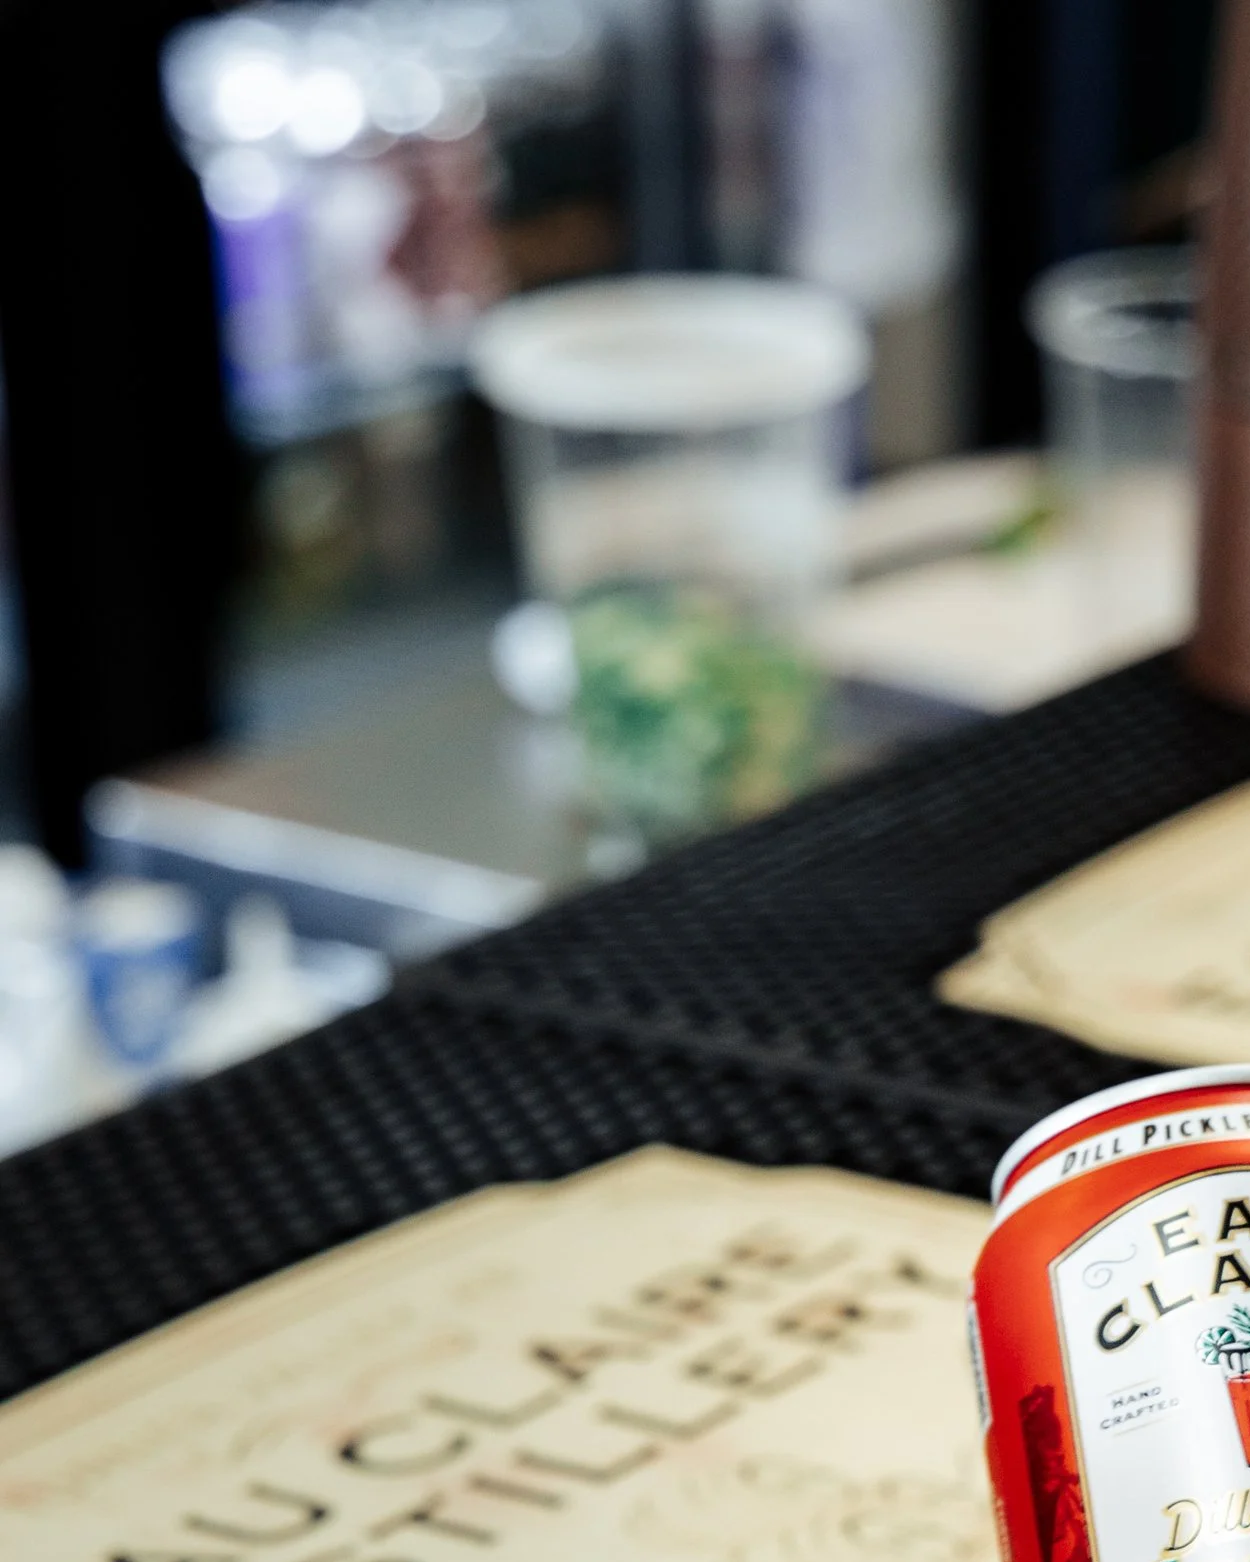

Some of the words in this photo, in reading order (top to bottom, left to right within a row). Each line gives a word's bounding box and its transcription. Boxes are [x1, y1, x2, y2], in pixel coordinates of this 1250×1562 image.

[1060, 1137, 1123, 1176] DILL
[335, 1222, 868, 1477] CLAIRE
[1100, 1397, 1180, 1431] CRAFTED
[1112, 1386, 1162, 1410] HAND
